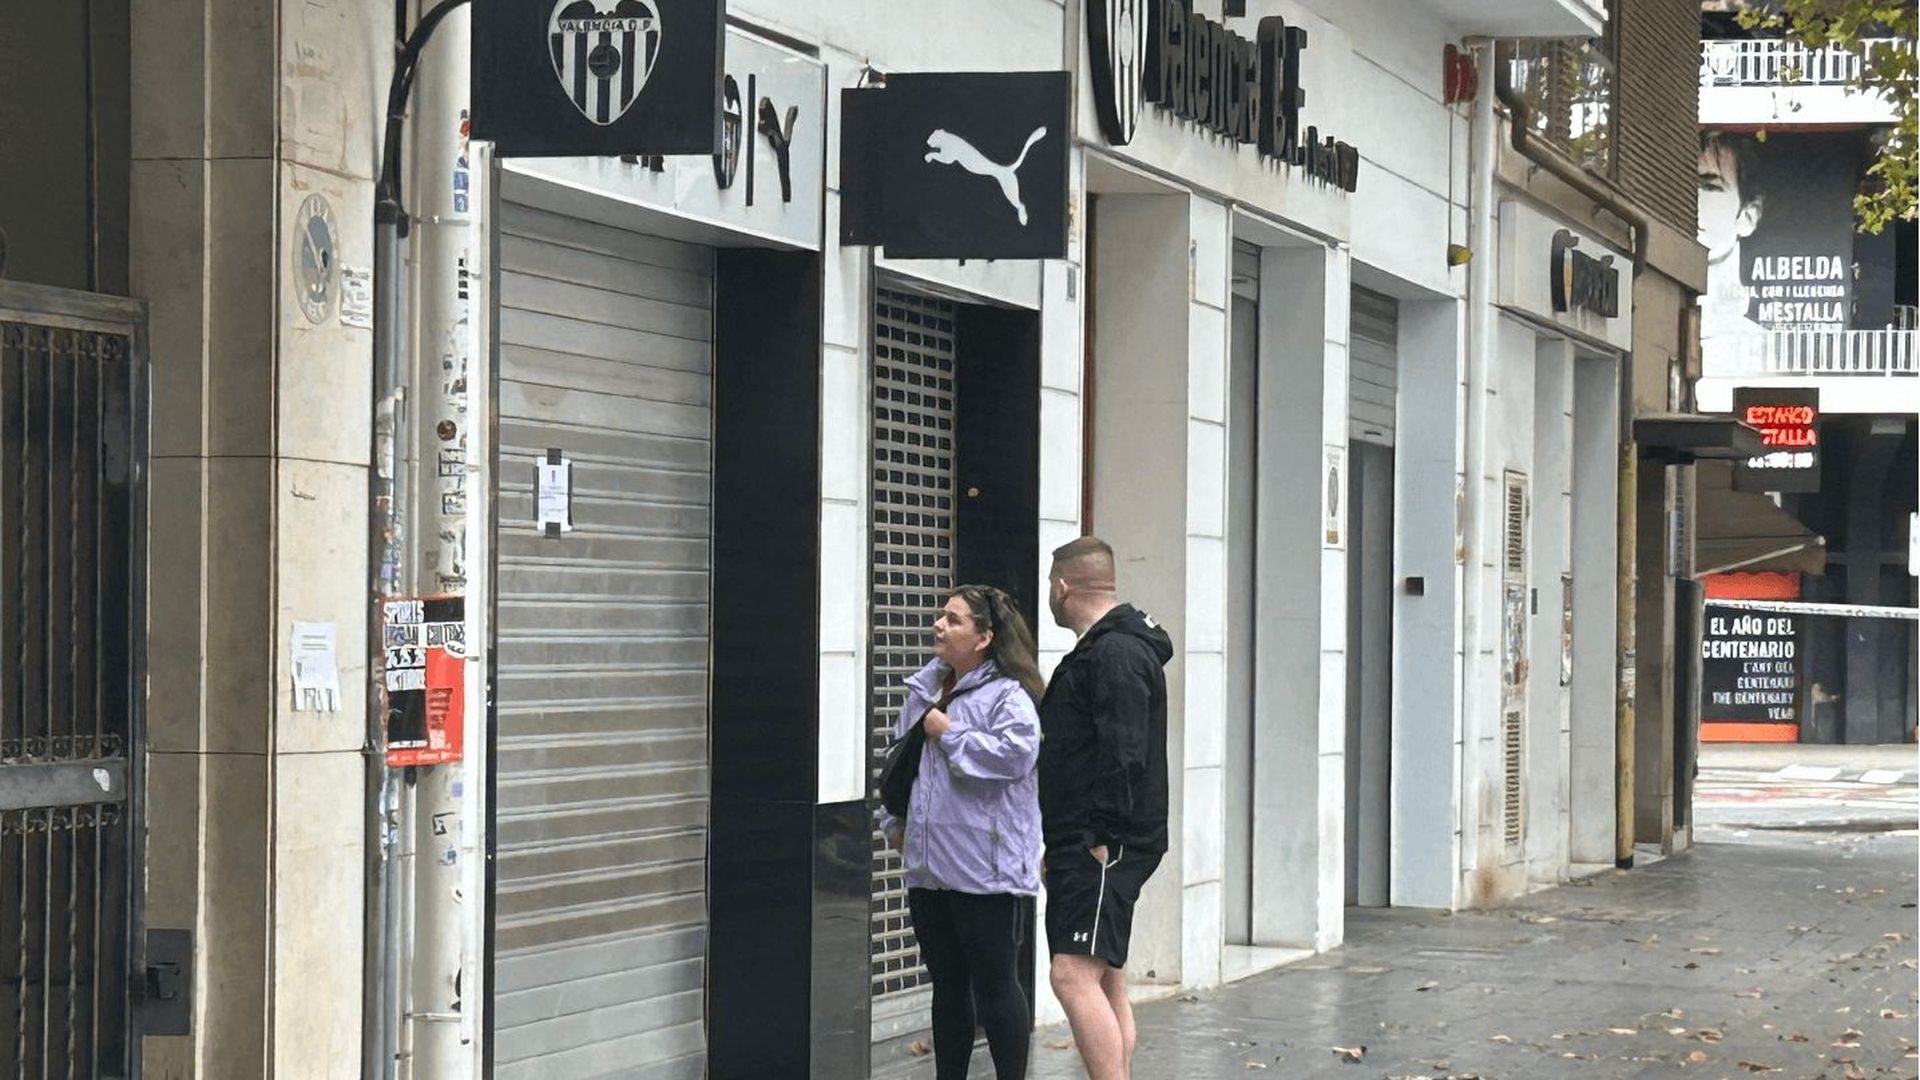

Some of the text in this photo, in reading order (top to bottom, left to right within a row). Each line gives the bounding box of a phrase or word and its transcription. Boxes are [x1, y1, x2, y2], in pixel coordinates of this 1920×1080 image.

[558, 19, 625, 32] VALENCIA
[1751, 256, 1843, 280] ALBELDA
[1758, 301, 1844, 322] MESTALLA
[1746, 406, 1814, 425] ESTANCO
[1710, 614, 1795, 636] EL AÑO DEL
[1702, 640, 1795, 659] CENTENARIO
